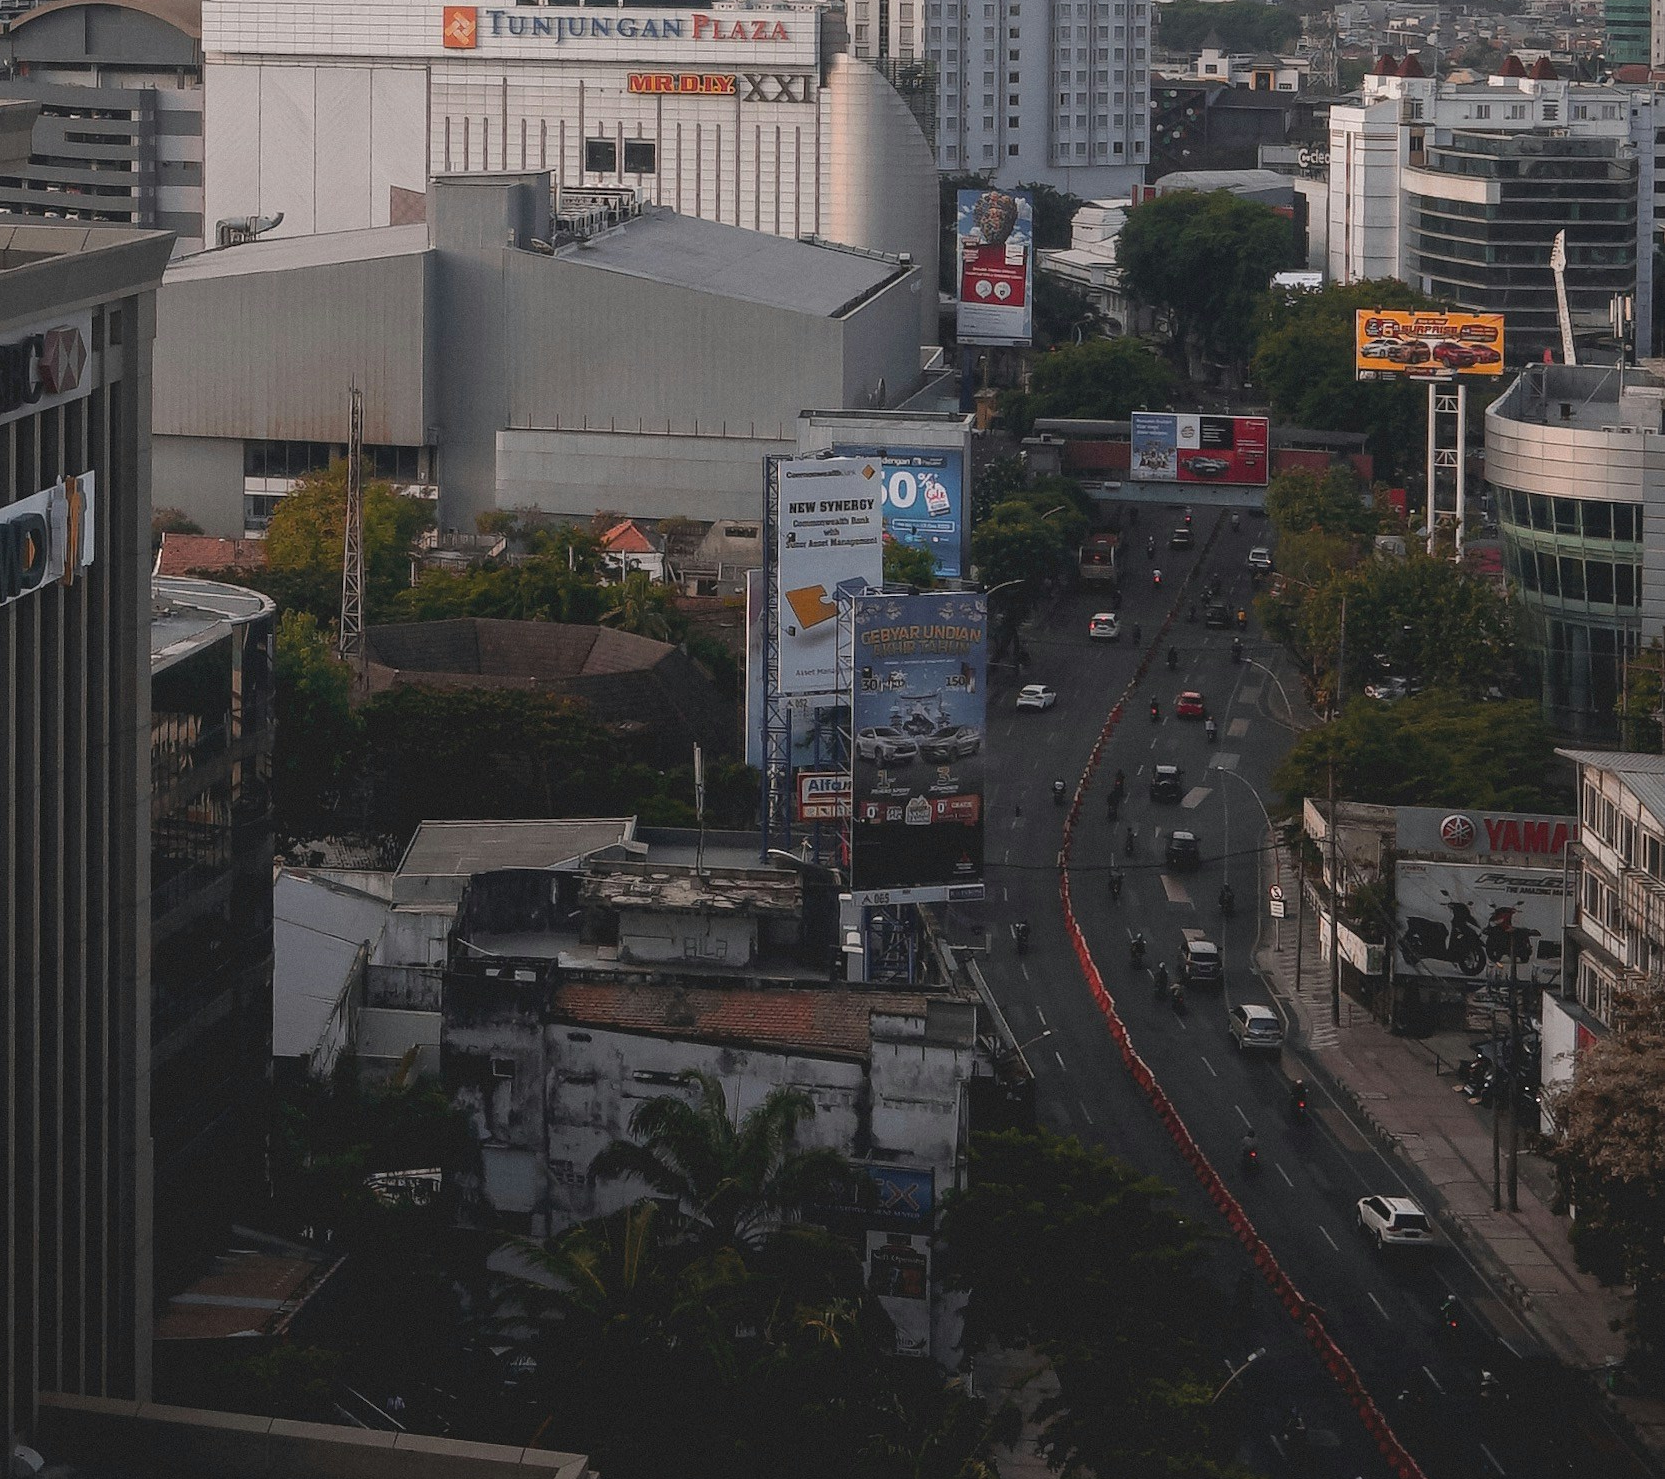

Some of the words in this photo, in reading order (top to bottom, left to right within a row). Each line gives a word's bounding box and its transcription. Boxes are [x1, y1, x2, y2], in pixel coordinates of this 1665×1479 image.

[485, 10, 683, 43] TUNJUNGAN
[691, 13, 791, 41] PLAZA
[628, 74, 674, 93] MR
[742, 73, 815, 103] XXI
[789, 502, 815, 514] NEW
[819, 499, 874, 513] SYNERGY
[861, 625, 920, 645] GEBYAR
[923, 624, 982, 644] UNDIAN
[808, 779, 851, 791] Alfam
[1484, 818, 1579, 855] YAMA
[1506, 886, 1518, 894] THE
[1519, 887, 1551, 896] AMAZING
